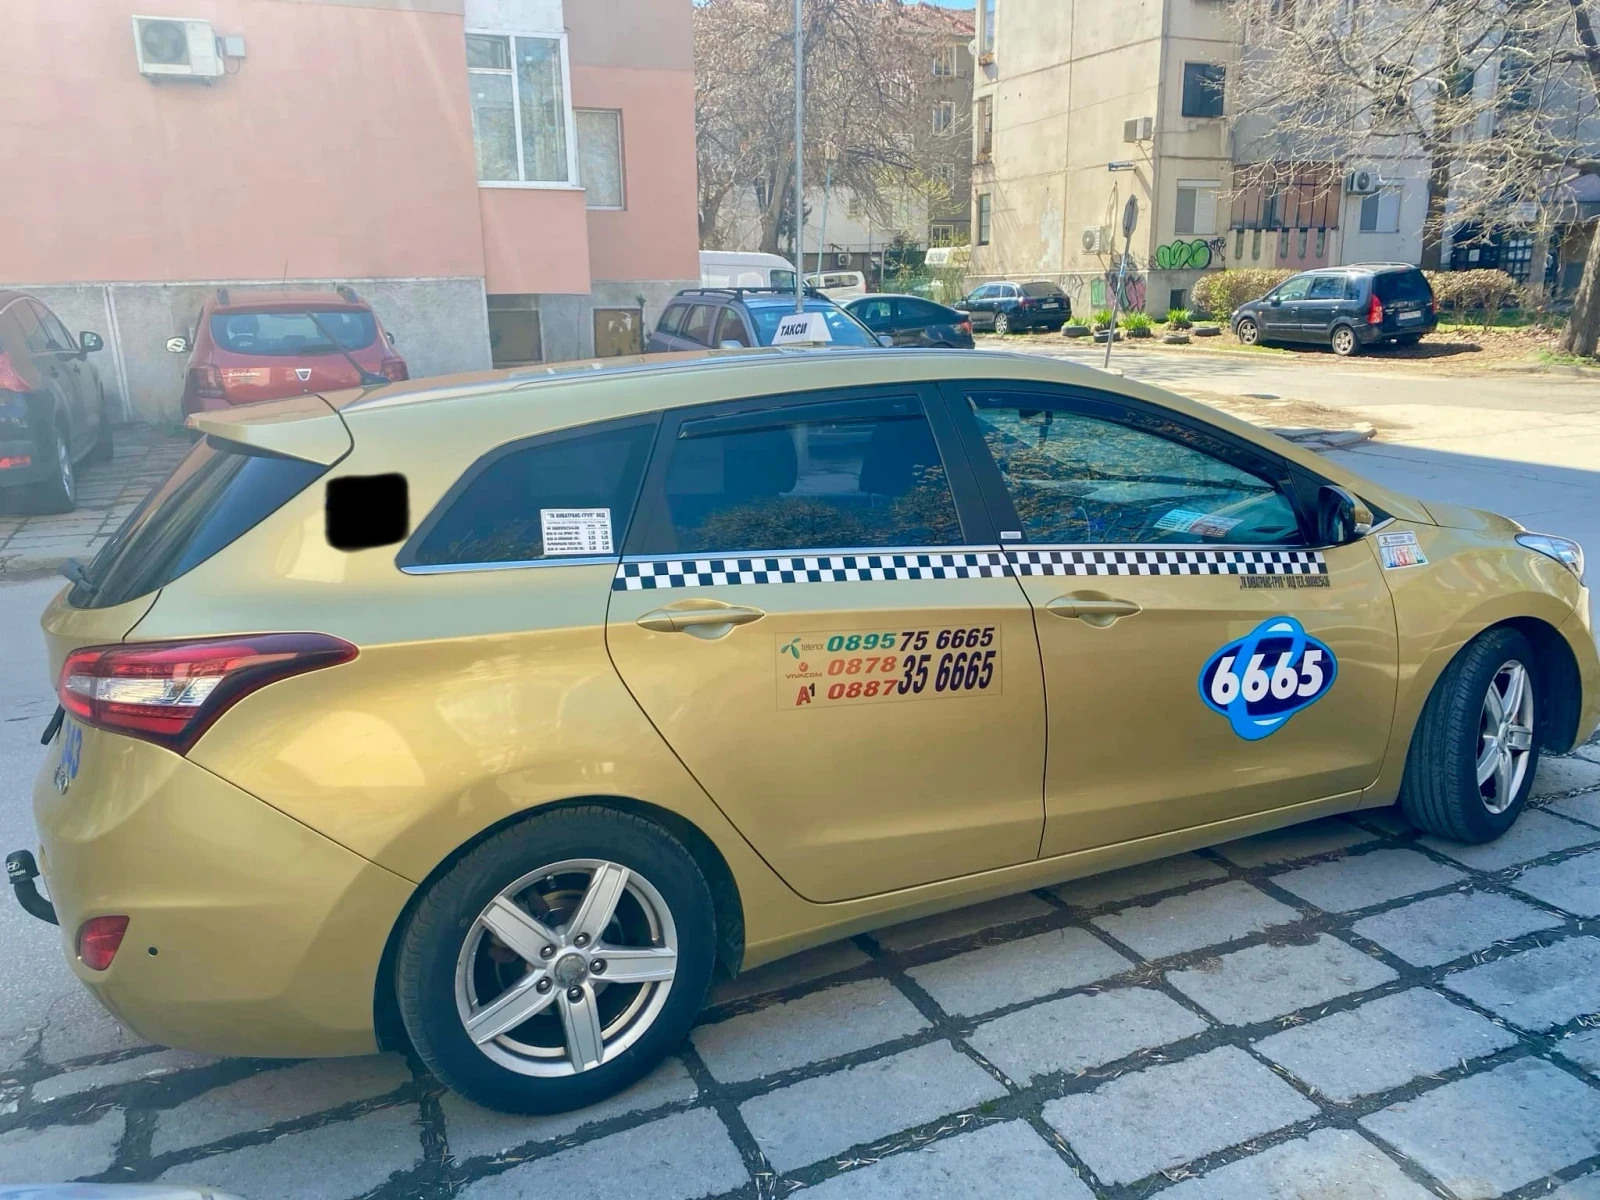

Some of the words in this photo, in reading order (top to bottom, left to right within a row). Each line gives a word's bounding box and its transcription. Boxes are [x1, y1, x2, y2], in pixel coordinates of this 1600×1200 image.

[780, 323, 808, 337] ТАКСИ
[801, 643, 825, 652] telenor
[826, 632, 897, 653] 0895
[899, 630, 930, 652] 75
[935, 627, 995, 650] 6665
[785, 672, 823, 680] VIVACOM
[827, 655, 897, 677] 0878
[897, 653, 932, 696] 35
[935, 650, 997, 693] 6665
[1211, 649, 1324, 705] 6665
[795, 682, 816, 707] A1
[827, 679, 899, 700] 0887
